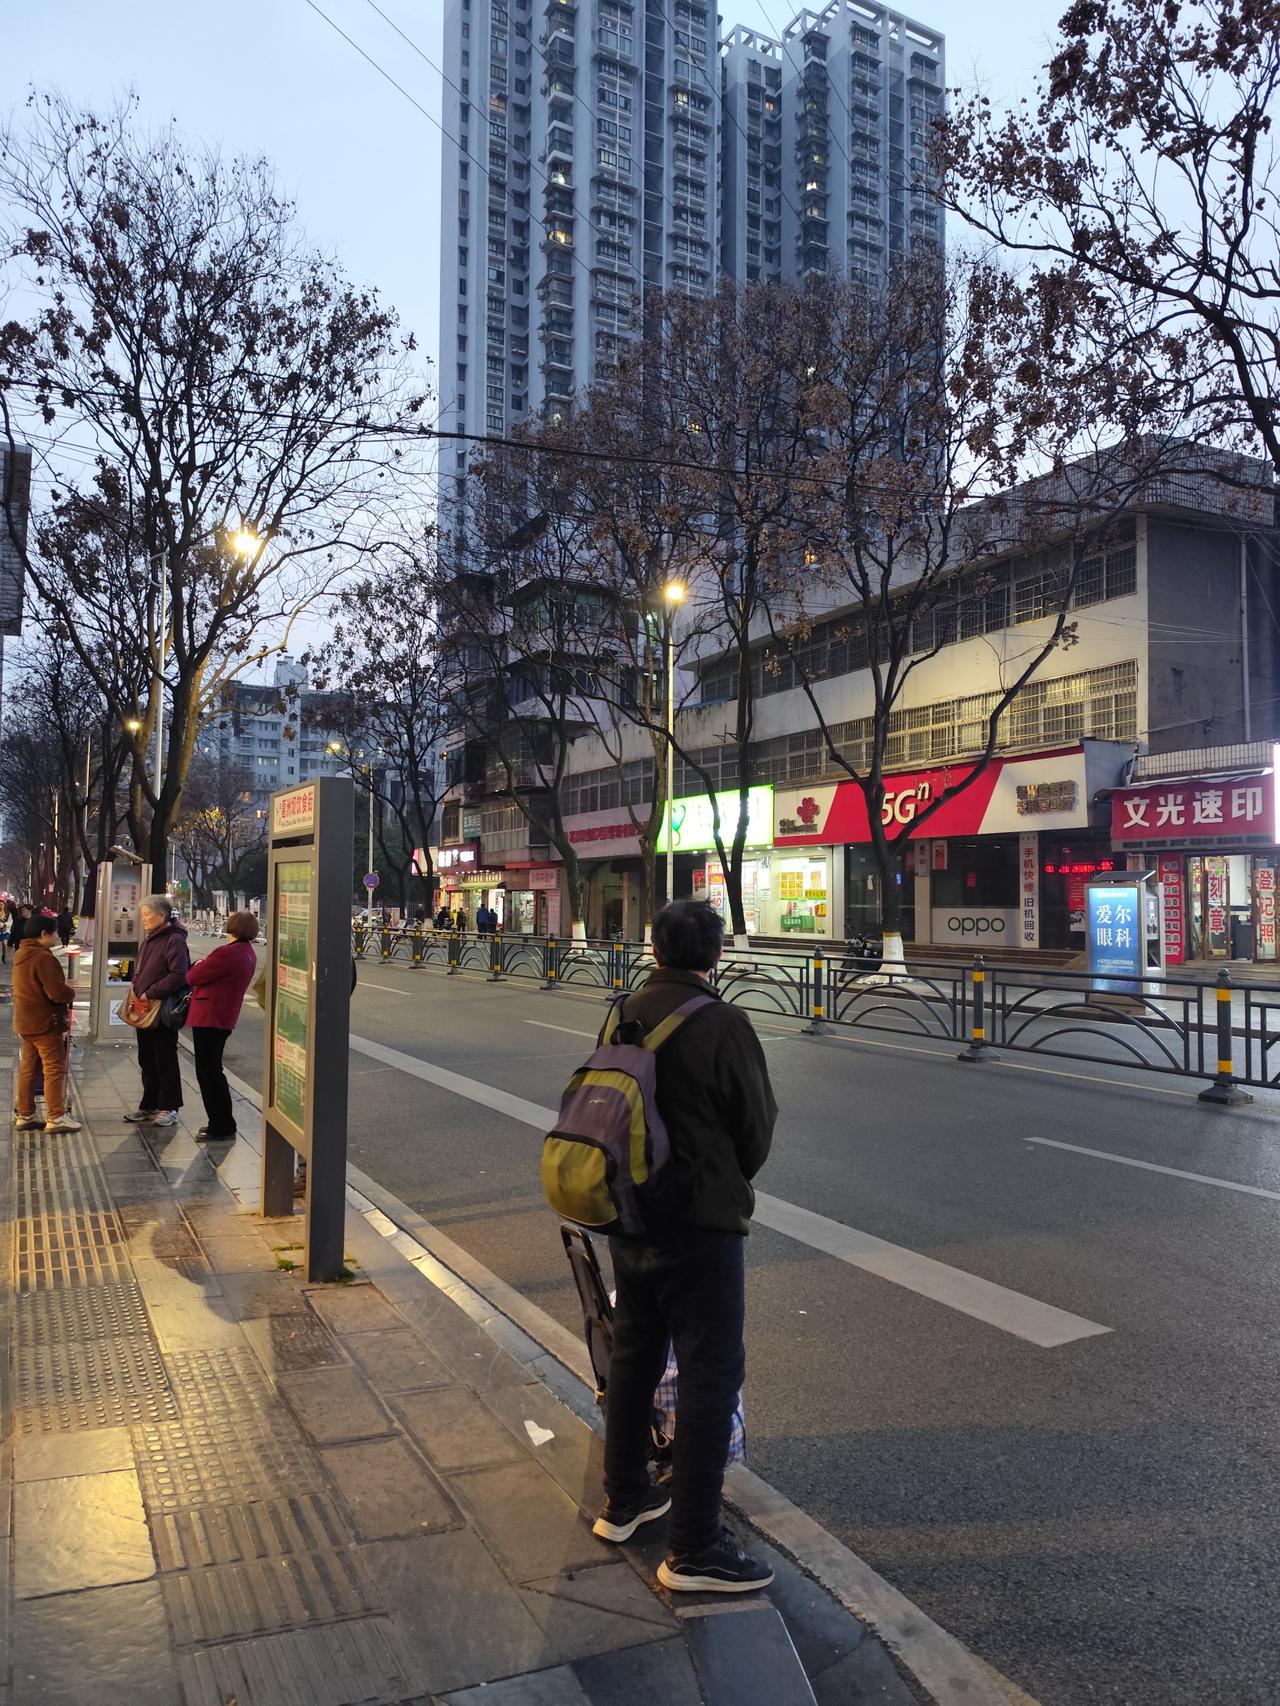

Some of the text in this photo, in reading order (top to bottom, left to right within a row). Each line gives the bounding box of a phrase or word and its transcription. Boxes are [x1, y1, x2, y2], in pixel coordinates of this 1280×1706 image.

[1123, 787, 1263, 829] 文光速印
[1024, 848, 1034, 893] 手机快修
[1024, 897, 1034, 942] 旧机回收
[1096, 904, 1132, 925] 爱尔
[1209, 873, 1224, 933] 刻章
[1260, 870, 1274, 943] 登记照
[1096, 928, 1132, 948] 眼科
